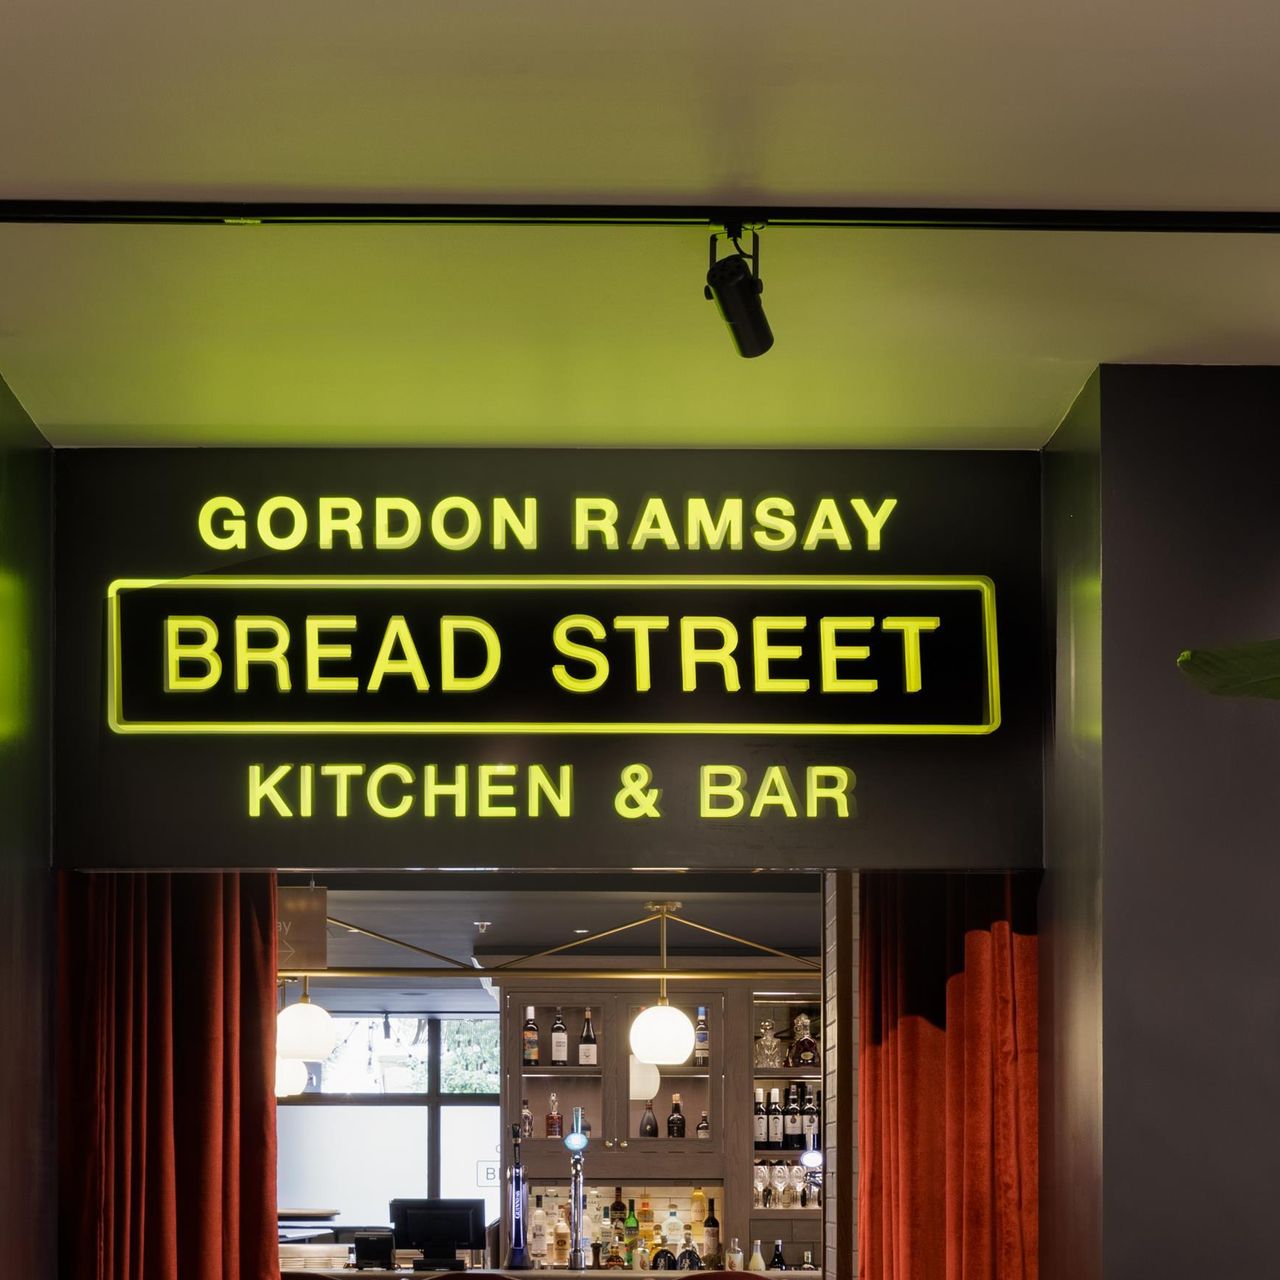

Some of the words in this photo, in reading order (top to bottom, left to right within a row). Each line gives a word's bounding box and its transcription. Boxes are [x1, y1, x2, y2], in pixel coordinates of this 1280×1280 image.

[198, 495, 538, 551] GORDON
[573, 496, 898, 551] RAMSAY
[165, 615, 502, 692] BREAD
[552, 614, 941, 692] STREET
[248, 763, 574, 819] KITCHEN
[614, 763, 662, 819] &
[700, 764, 854, 819] BAR
